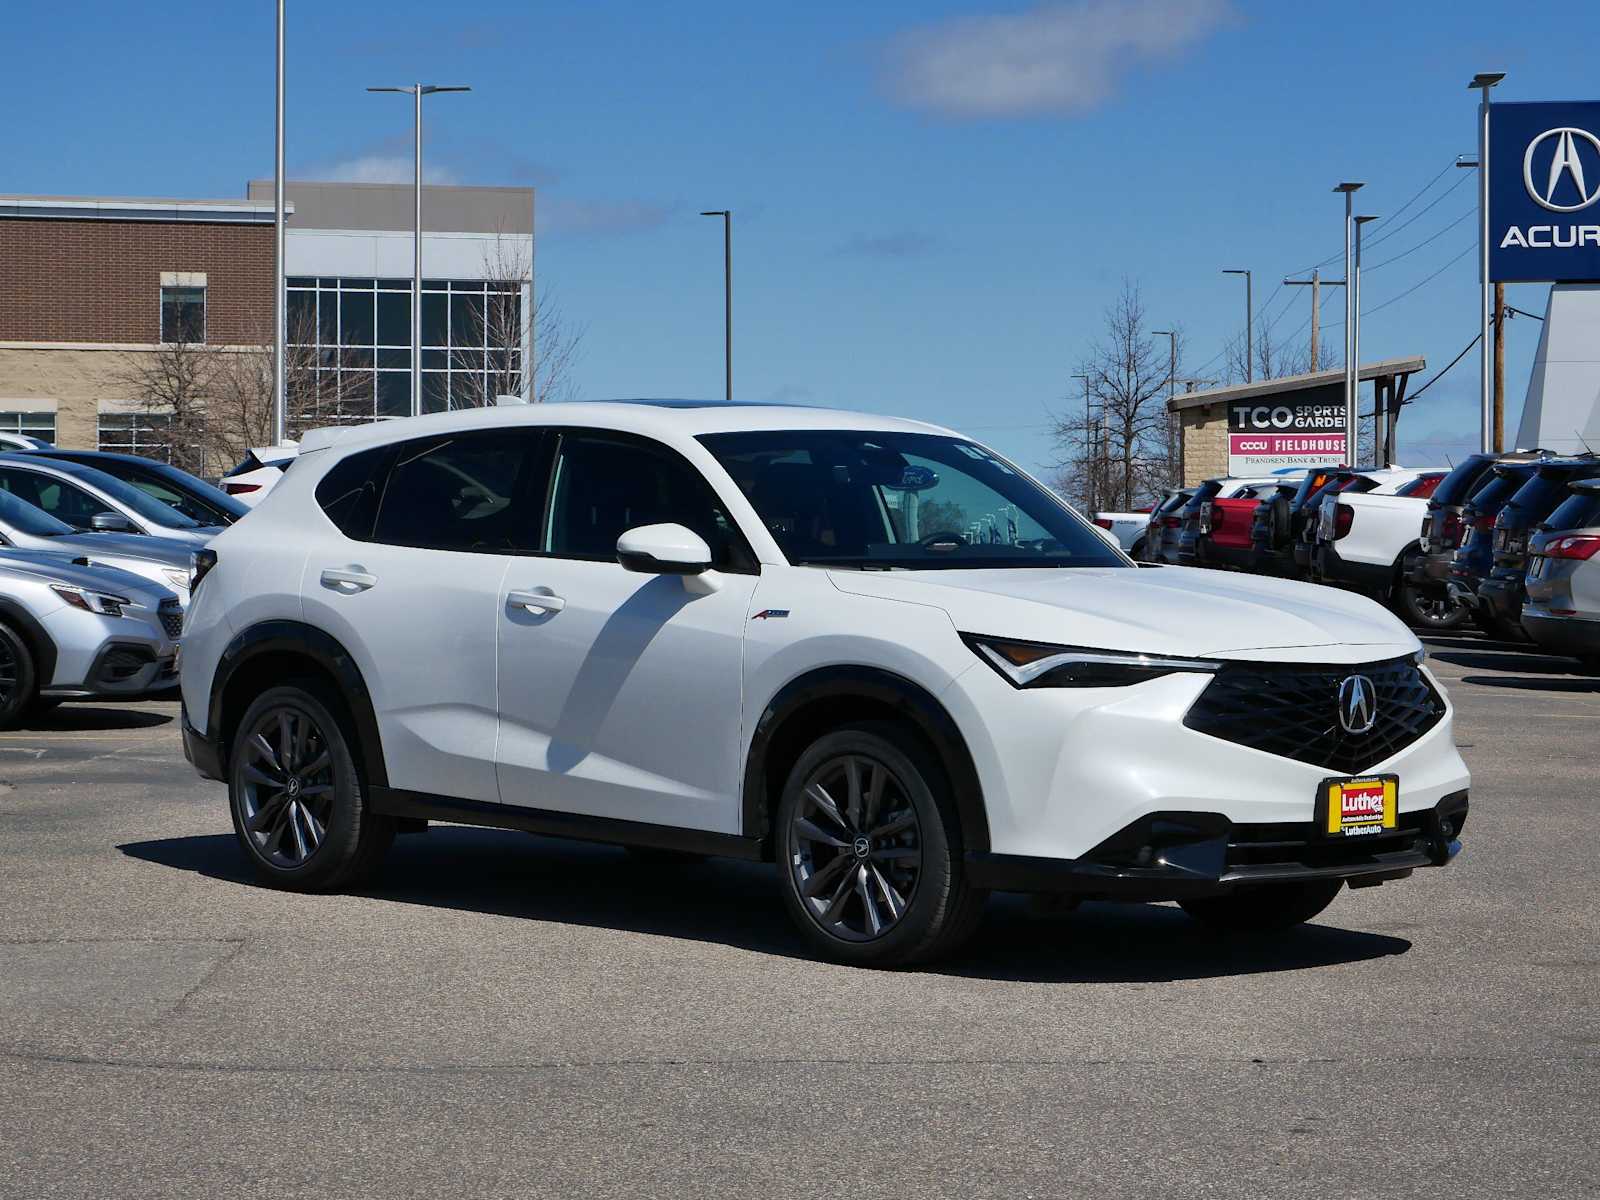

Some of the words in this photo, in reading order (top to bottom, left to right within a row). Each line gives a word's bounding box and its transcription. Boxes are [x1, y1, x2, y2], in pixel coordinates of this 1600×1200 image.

[1500, 225, 1600, 248] ACUR
[1296, 405, 1346, 417] SPORTS
[1233, 406, 1294, 429] TCO
[1295, 417, 1346, 428] GARDE
[1275, 440, 1346, 451] FIELDHOUSE
[1342, 792, 1383, 812] Luther
[1345, 825, 1382, 836] LutherAuto
